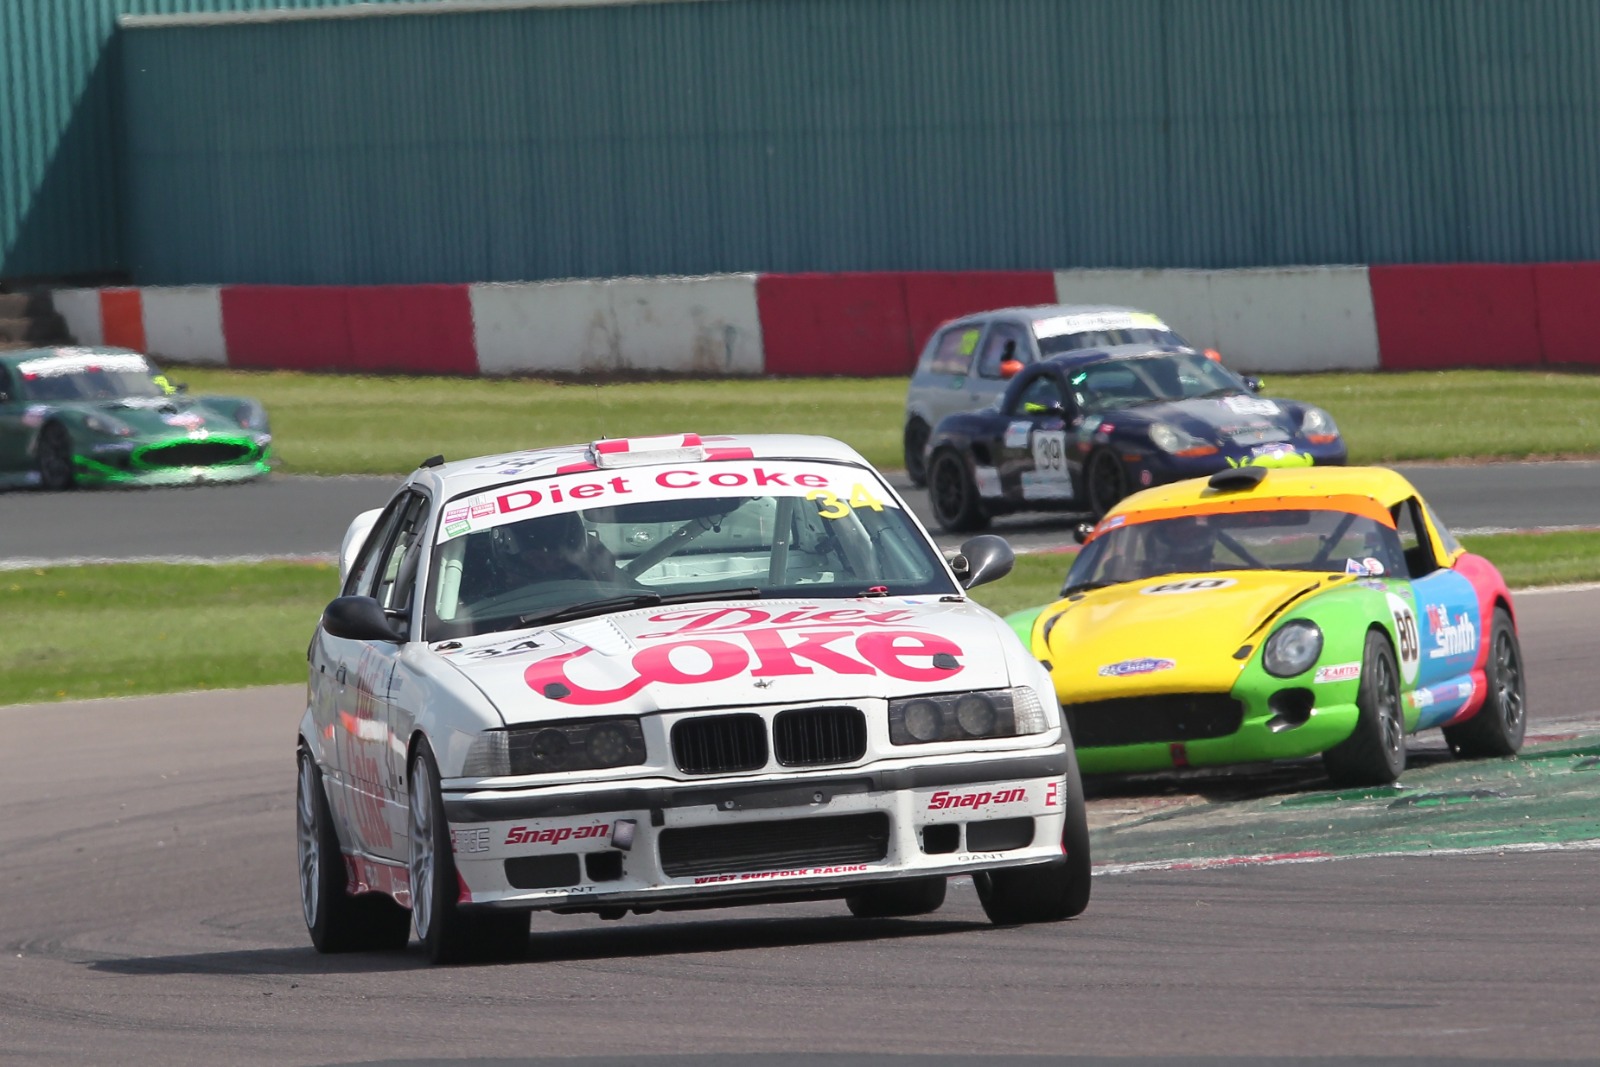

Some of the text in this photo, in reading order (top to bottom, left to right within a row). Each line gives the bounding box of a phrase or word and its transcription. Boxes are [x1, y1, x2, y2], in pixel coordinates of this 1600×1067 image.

[1038, 437, 1061, 470] 39
[496, 475, 633, 514] Diet
[655, 468, 829, 489] Coke
[806, 483, 884, 519] 34
[636, 605, 920, 639] Diet
[1393, 609, 1419, 662] 80
[465, 640, 546, 659] 34
[523, 629, 964, 706] Coke
[928, 787, 1026, 810] Snap-on
[504, 824, 610, 845] Snap-on
[694, 864, 868, 884] WEST SUFFOLK RACING
